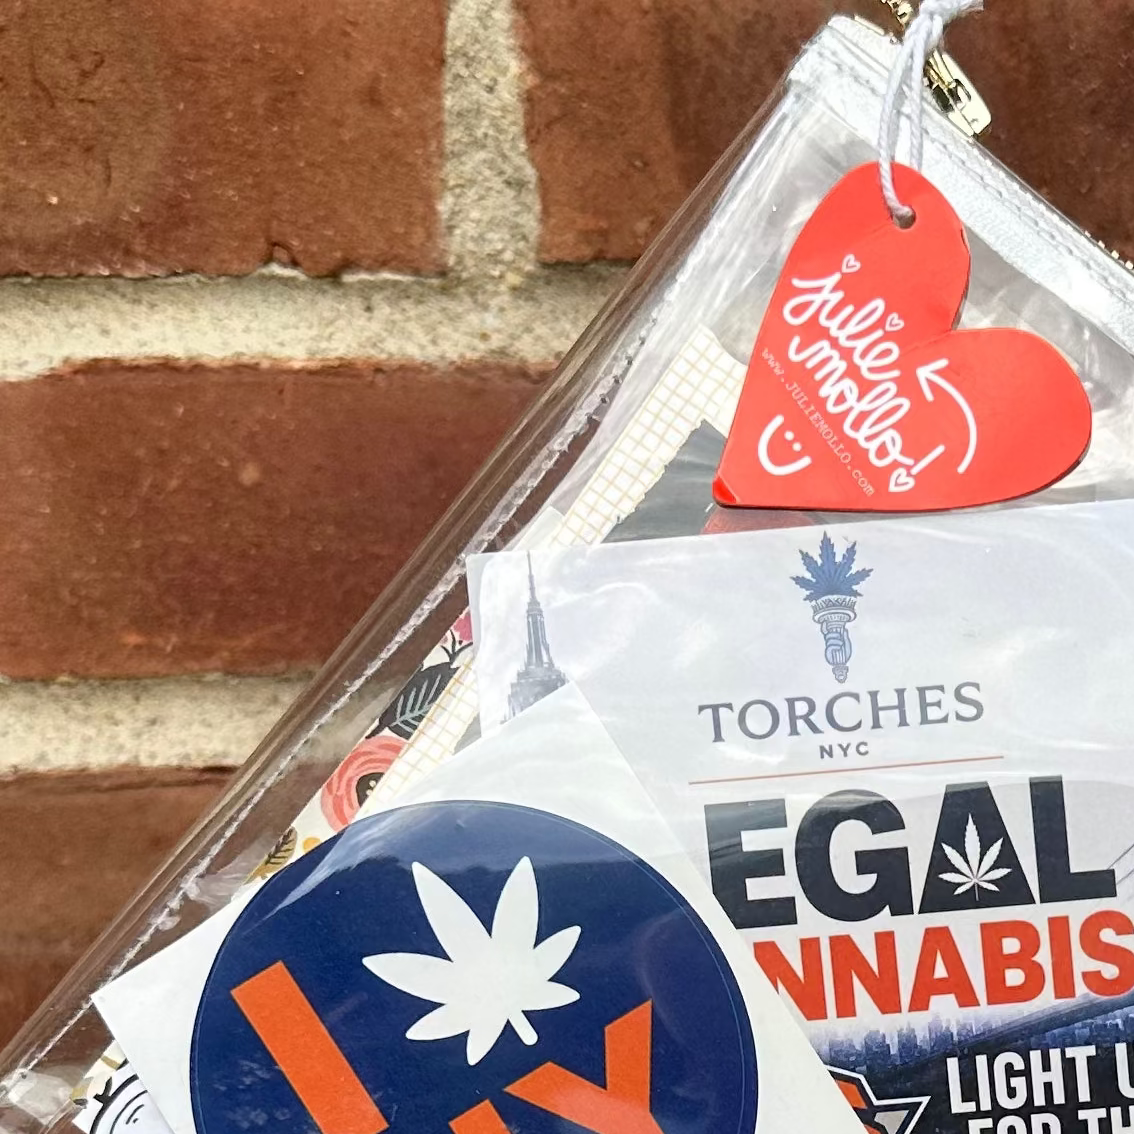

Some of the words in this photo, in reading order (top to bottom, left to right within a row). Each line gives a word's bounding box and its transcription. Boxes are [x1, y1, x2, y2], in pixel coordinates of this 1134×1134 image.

[697, 681, 985, 744] TORCHES
[818, 741, 870, 760] NYC
[703, 774, 1117, 930] EGAL
[947, 1046, 1096, 1113] LIGHT
